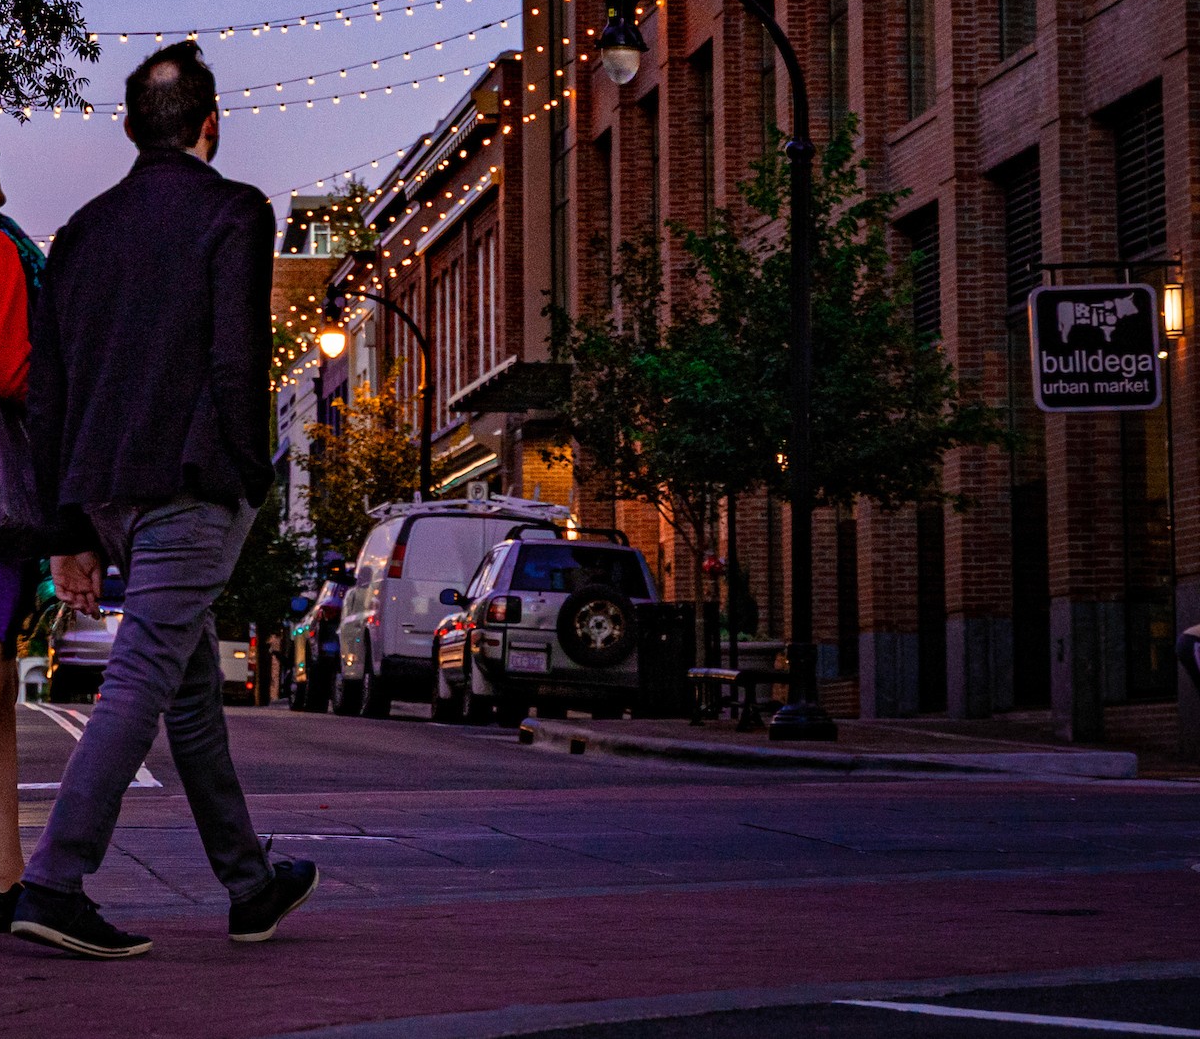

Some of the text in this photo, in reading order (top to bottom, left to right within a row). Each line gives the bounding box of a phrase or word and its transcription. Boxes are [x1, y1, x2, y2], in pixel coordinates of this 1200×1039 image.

[1041, 349, 1153, 377] bulldega
[1042, 377, 1151, 394] urban market
